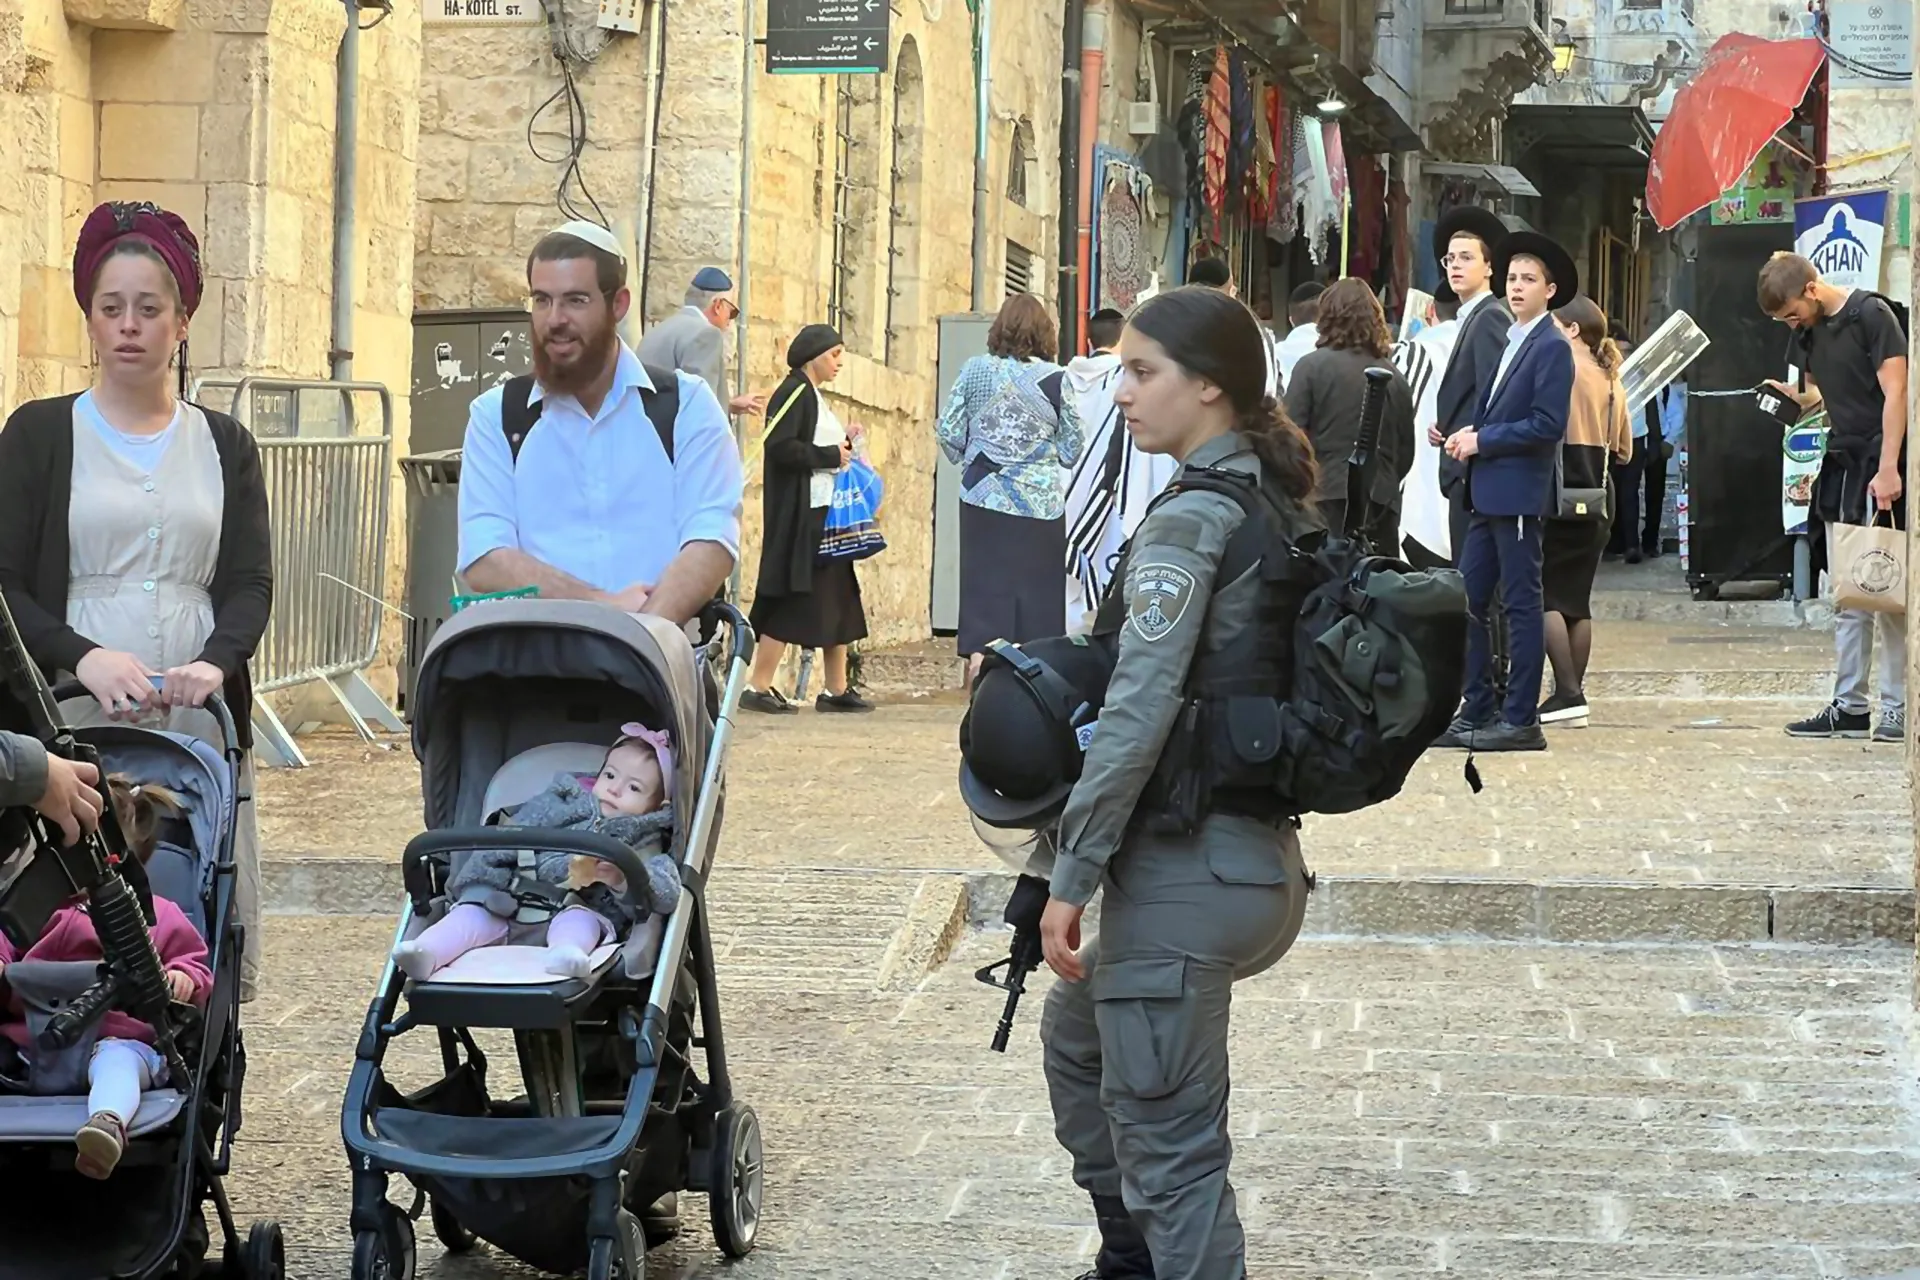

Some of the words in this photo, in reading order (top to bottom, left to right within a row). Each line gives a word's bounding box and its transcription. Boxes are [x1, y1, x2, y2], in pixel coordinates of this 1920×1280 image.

[444, 0, 499, 16] HA-KOTEL
[506, 5, 522, 16] ST.
[1813, 243, 1863, 275] KHAN
